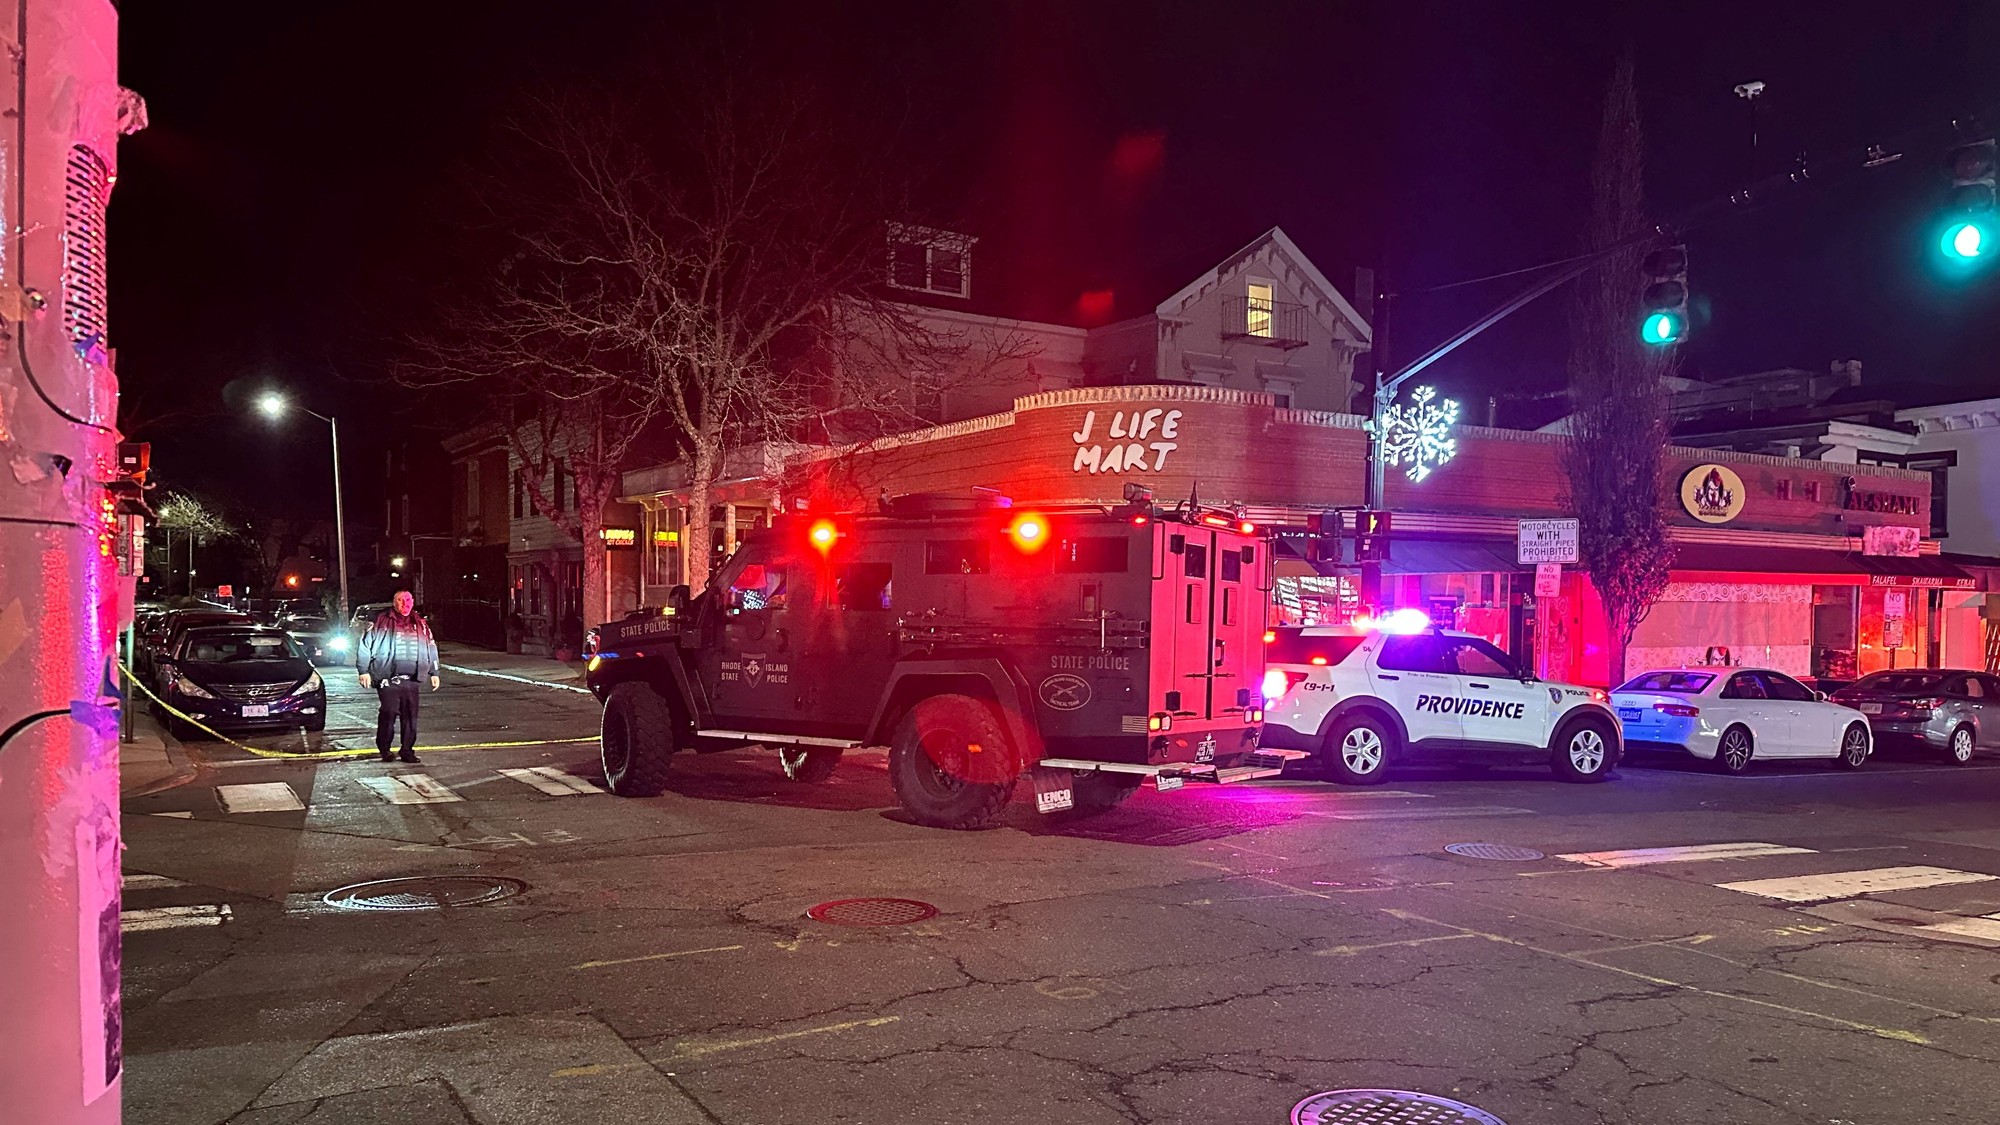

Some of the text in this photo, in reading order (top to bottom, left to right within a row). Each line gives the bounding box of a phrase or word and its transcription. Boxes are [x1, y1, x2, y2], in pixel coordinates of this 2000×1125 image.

[1073, 408, 1182, 443] J LIFE
[1073, 442, 1177, 474] MART
[1521, 522, 1576, 531] MOTORCYCLES
[1536, 531, 1560, 540] WITH
[1523, 547, 1574, 556] PROHIBITED
[1872, 576, 1897, 585] FALAFEL
[621, 621, 671, 638] STATE POLICE
[721, 662, 788, 672] RHODE ISLAND
[1051, 656, 1129, 670] STATE POLICE
[721, 672, 788, 683] STATE POLICE
[1565, 688, 1591, 697] POLICE
[1416, 694, 1525, 719] PROVIDENCE
[1037, 789, 1071, 805] LENCO
